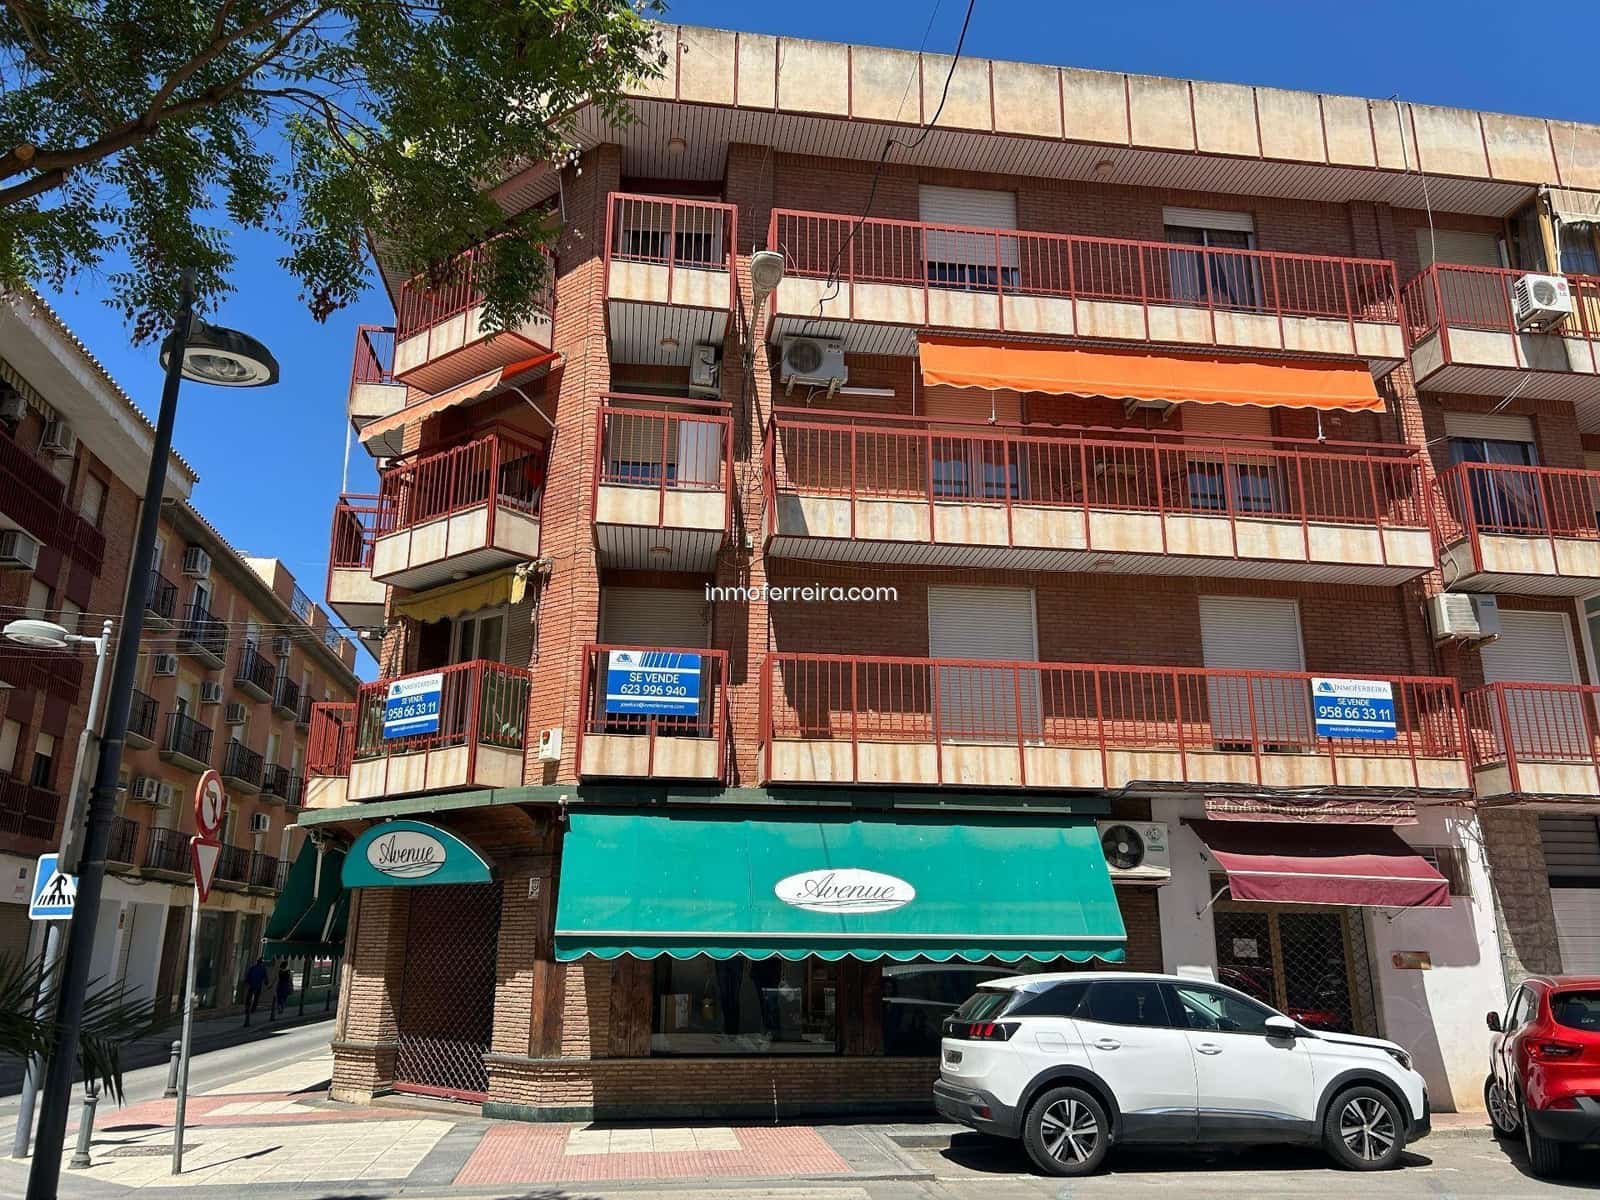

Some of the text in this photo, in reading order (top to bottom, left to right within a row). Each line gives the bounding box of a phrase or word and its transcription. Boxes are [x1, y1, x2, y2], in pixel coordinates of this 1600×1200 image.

[629, 672, 680, 684] SE VENDE
[620, 683, 687, 696] 623 996 940
[388, 701, 437, 720] 958 66 33 11
[1336, 698, 1371, 707] SE VENDE
[1319, 705, 1391, 721] 958 66 33 11
[379, 834, 434, 864] Avenue
[796, 872, 895, 899] Avenue
